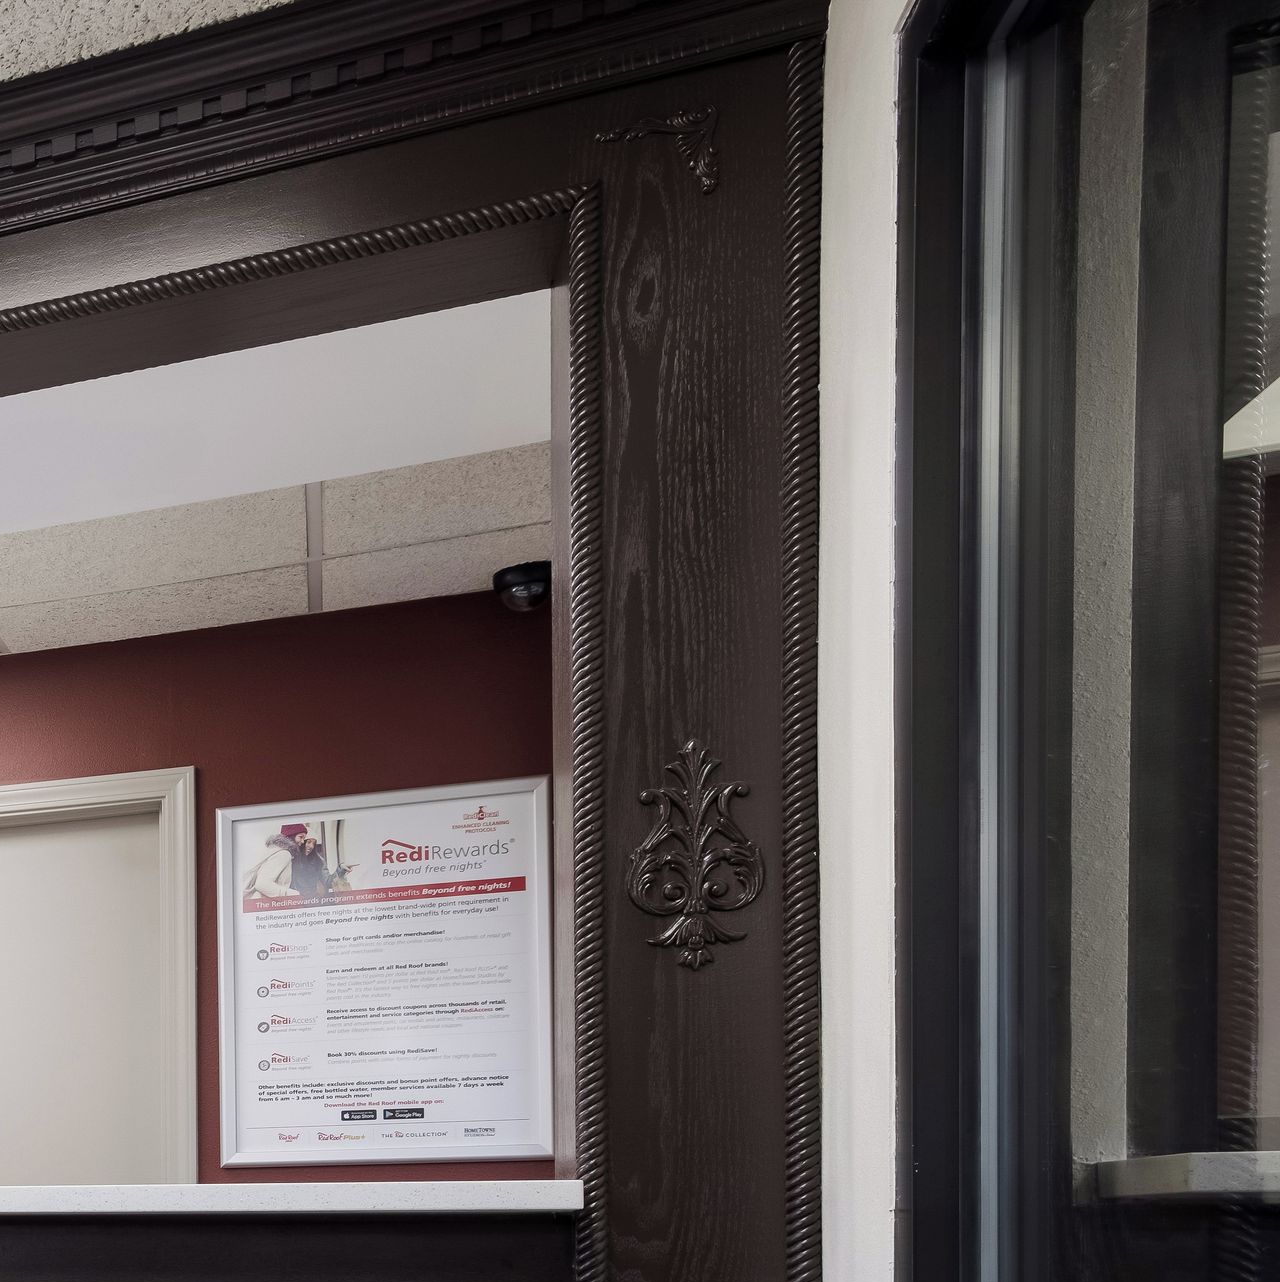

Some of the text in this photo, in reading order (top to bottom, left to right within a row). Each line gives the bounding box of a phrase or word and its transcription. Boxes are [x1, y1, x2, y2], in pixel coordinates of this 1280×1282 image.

[383, 866, 421, 879] Beyond
[425, 863, 446, 874] free
[272, 897, 319, 907] RediRewards
[321, 896, 354, 905] program
[356, 892, 386, 900] extends
[389, 889, 419, 898] benefits
[422, 886, 455, 897] Beyond
[479, 882, 511, 892] nights!
[256, 913, 296, 922] RediRewards
[332, 909, 352, 917] nights
[398, 902, 437, 910] brand-wide
[438, 900, 456, 909] point
[458, 897, 500, 907] requirement
[268, 921, 293, 930] industry
[325, 917, 352, 925] Beyond
[371, 914, 393, 922] nights
[412, 910, 439, 918] benefits
[453, 907, 483, 916] everyday
[270, 944, 308, 954] RediShop
[271, 981, 313, 990] RediPoints
[272, 1055, 308, 1063] RediSave
